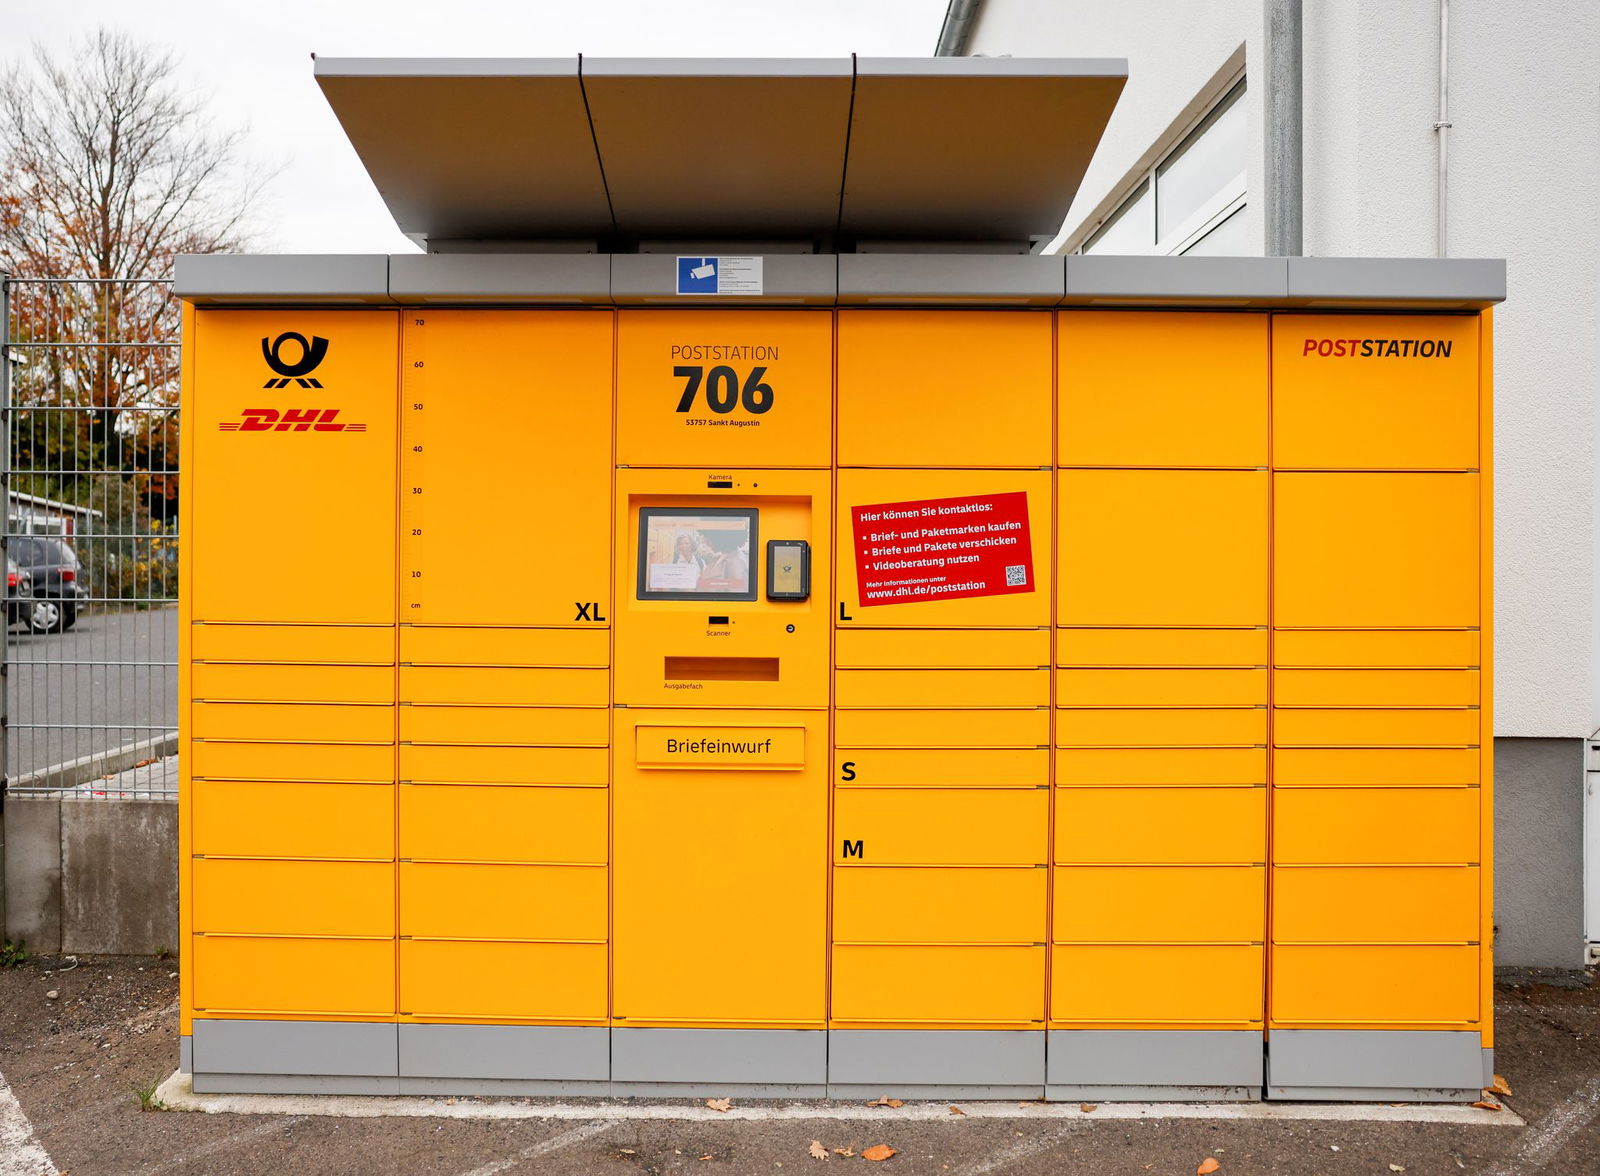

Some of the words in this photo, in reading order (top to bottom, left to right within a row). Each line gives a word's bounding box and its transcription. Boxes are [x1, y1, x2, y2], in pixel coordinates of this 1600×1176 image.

[415, 319, 425, 328] 70
[671, 345, 779, 361] POSTSTATION
[1303, 339, 1453, 358] POSTSTATION
[414, 361, 425, 369] 60
[673, 366, 774, 415] 706
[413, 403, 424, 411] 50
[238, 409, 347, 431] DHL
[686, 419, 707, 427] 53757
[708, 419, 728, 427] Sankt
[729, 419, 760, 428] Augustin
[412, 445, 423, 453] 40
[412, 487, 423, 495] 30
[860, 512, 881, 522] Hier
[883, 509, 919, 520] können
[921, 507, 936, 517] Sie
[938, 502, 993, 515] kontaktlos:
[411, 528, 422, 536] 20
[871, 531, 899, 542] Brief-
[900, 528, 919, 539] und
[921, 524, 986, 538] Paketmarken
[988, 520, 1022, 532] kaufen
[872, 545, 902, 556] Briefe
[903, 543, 922, 553] und
[924, 541, 957, 552] Pakete
[959, 536, 1017, 549] verschicken
[873, 557, 945, 571] Videoberatung
[946, 554, 980, 564] nutzen
[411, 570, 422, 578] 10
[865, 580, 882, 588] Mehr
[883, 577, 929, 587] Informationen
[929, 575, 947, 583] unter
[866, 580, 986, 599] www.dhl.de/poststation
[575, 602, 606, 621] XL
[840, 602, 853, 621] L
[667, 739, 771, 754] Briefeinwurf
[842, 762, 857, 781] S
[843, 840, 864, 859] M
